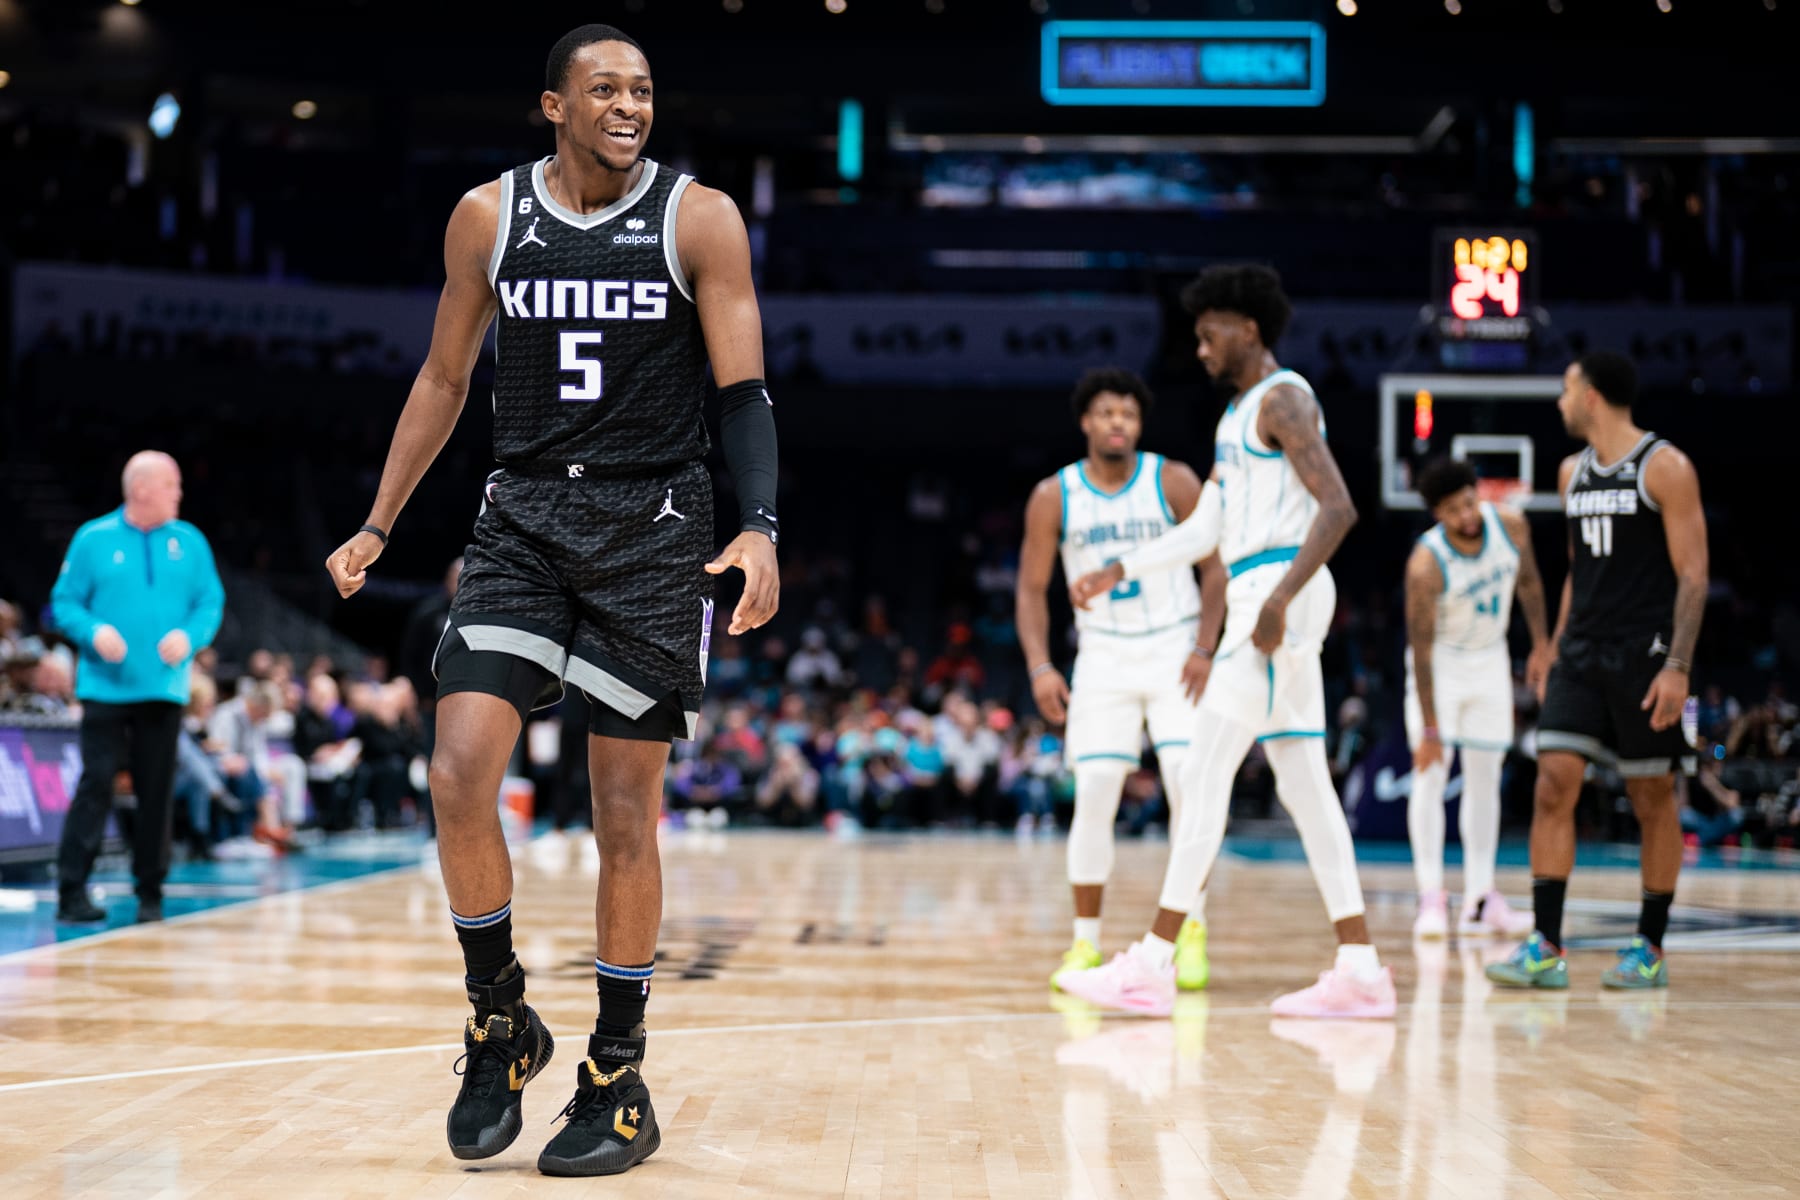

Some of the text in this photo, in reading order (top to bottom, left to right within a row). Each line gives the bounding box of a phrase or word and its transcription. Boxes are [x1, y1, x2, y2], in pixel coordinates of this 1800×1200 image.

[518, 197, 533, 215] 6
[613, 233, 658, 246] dialpad
[499, 279, 669, 320] KINGS
[1451, 264, 1520, 320] 24
[559, 329, 604, 400] 5
[1565, 489, 1638, 518] KINGS
[1581, 516, 1612, 557] 41
[599, 1042, 638, 1059] ZAMST
